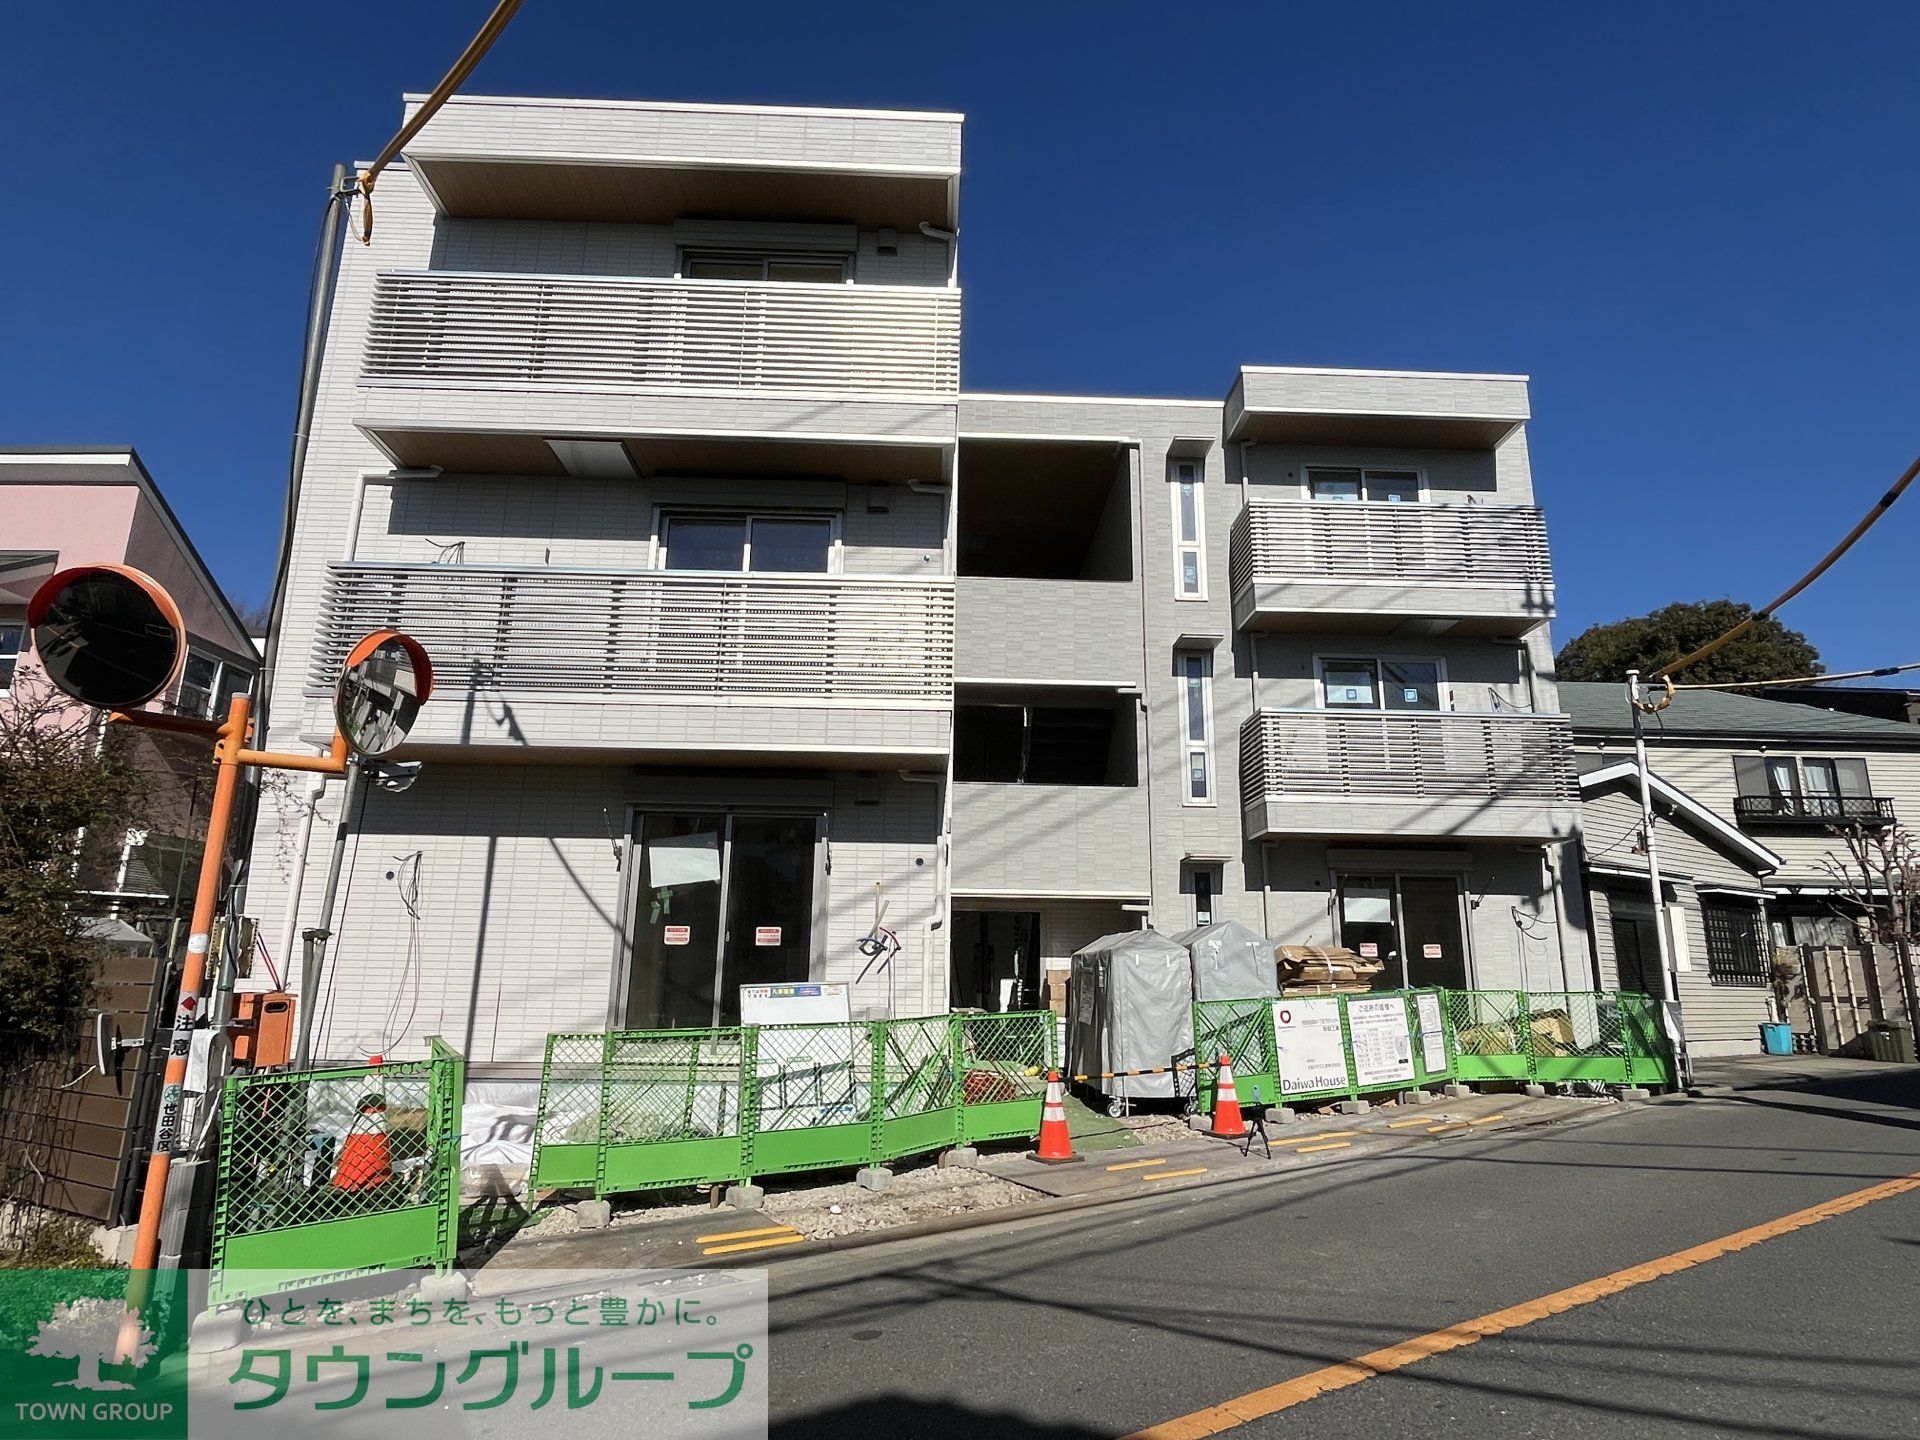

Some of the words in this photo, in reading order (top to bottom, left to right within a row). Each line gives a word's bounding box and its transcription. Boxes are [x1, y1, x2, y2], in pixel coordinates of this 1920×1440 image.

[170, 1014, 193, 1056] 注意
[156, 1102, 178, 1152] 世田谷区
